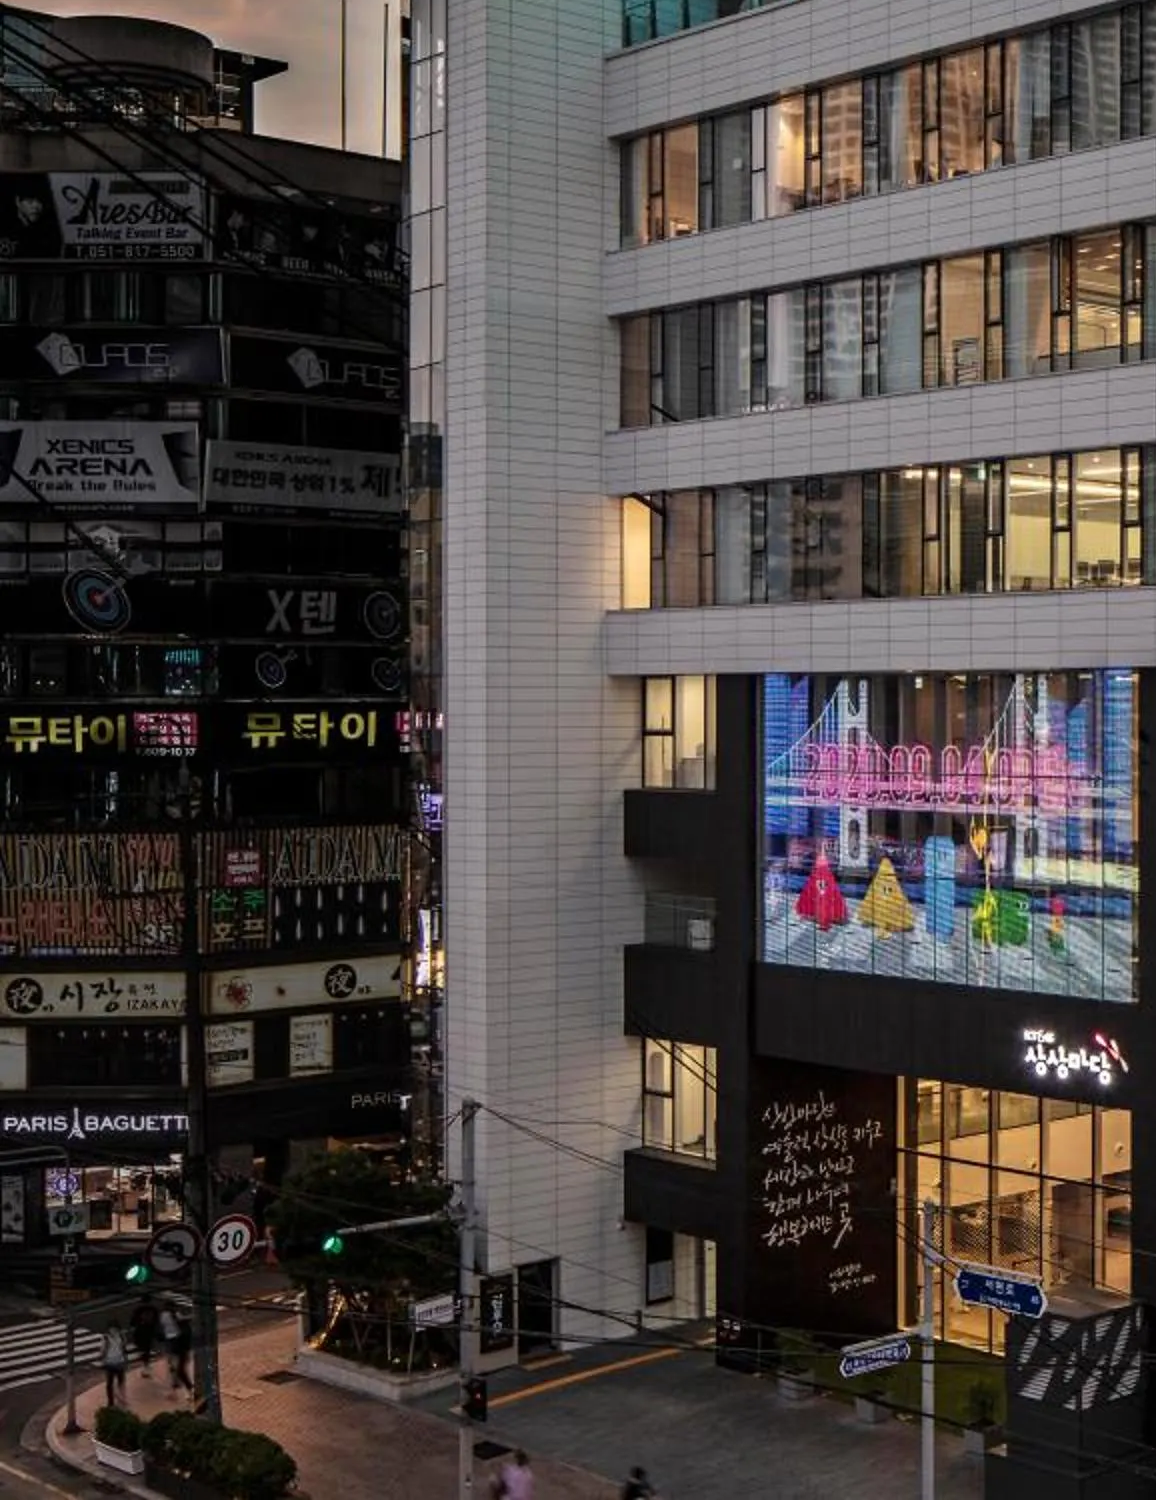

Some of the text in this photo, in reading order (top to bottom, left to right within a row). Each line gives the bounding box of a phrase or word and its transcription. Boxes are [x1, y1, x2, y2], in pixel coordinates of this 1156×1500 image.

[126, 227, 161, 239] Event
[165, 227, 189, 239] Bar
[46, 439, 135, 455] XENICS
[29, 457, 153, 476] ARENA
[81, 479, 107, 492] the
[5, 713, 128, 753] 뮤타이
[241, 710, 378, 748] 뮤타이
[60, 977, 122, 1012] 시장
[3, 1116, 68, 1132] PARIS
[217, 1229, 245, 1253] 30
